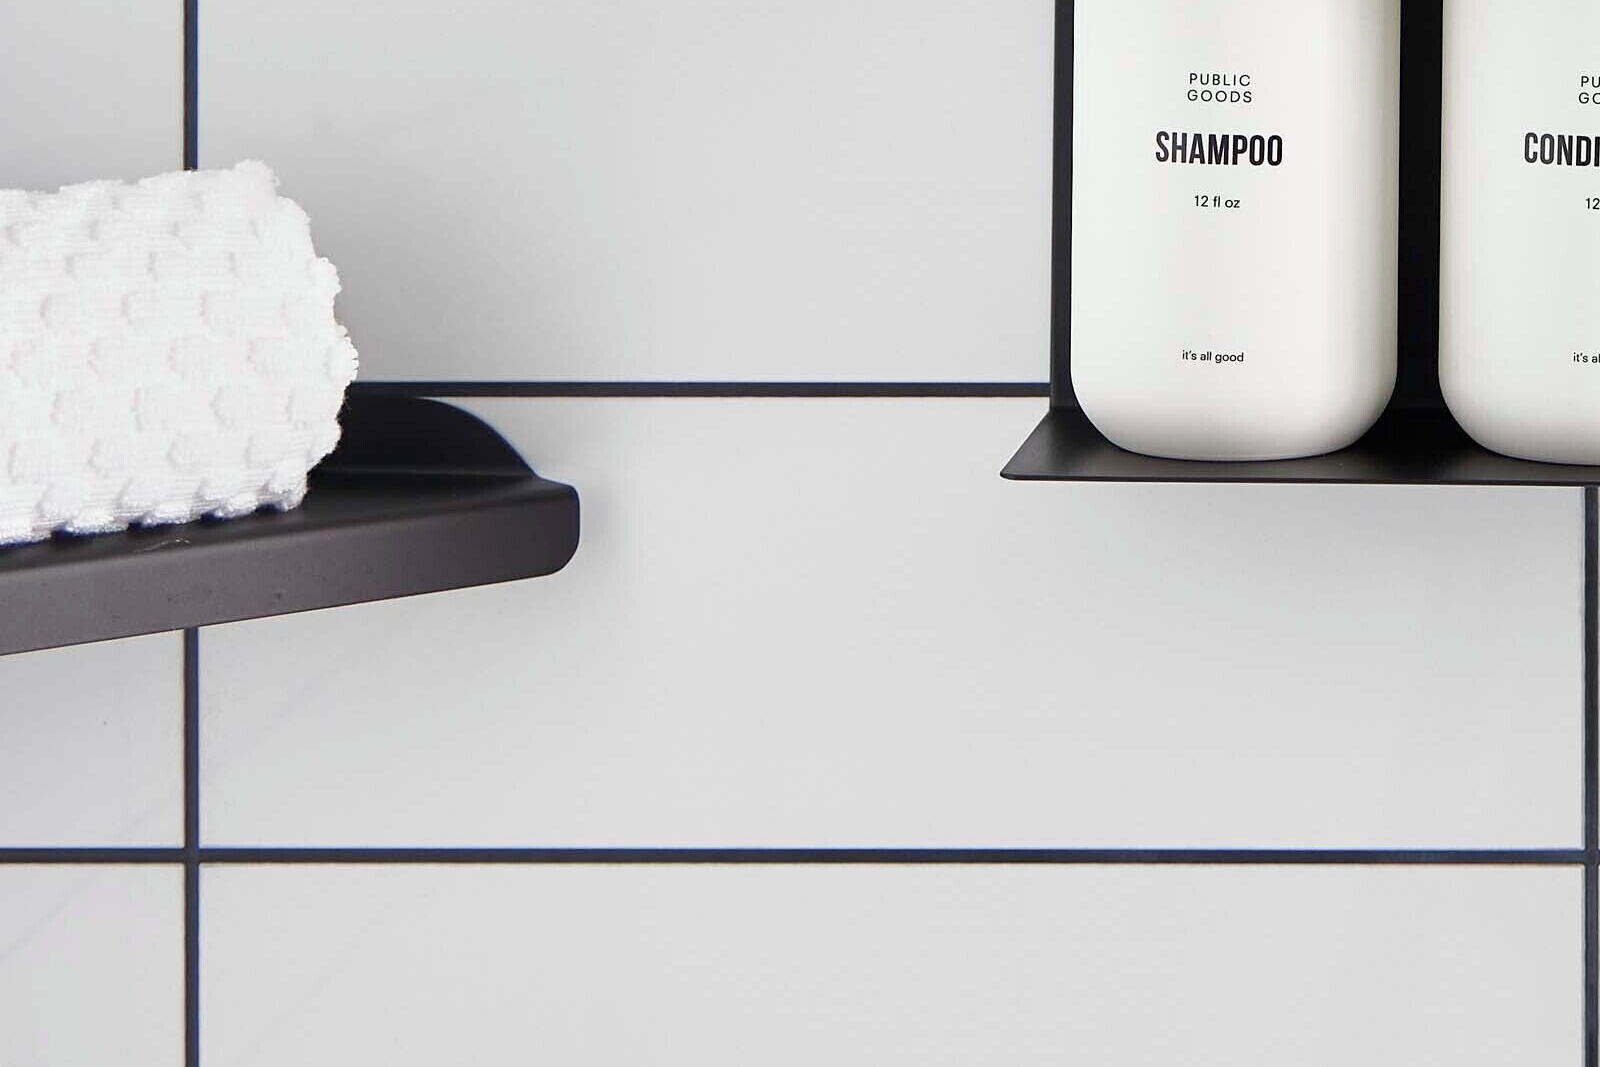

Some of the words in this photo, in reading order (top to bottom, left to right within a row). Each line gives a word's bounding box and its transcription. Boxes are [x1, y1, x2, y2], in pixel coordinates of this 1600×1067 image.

[1189, 72, 1251, 87] PUBLIC
[1187, 89, 1252, 104] GOODS
[1155, 130, 1283, 167] SHAMPOO
[1194, 195, 1209, 208] 12
[1213, 195, 1221, 208] fl
[1224, 199, 1241, 209] oz
[1585, 197, 1600, 211] 12
[1182, 349, 1197, 361] it's
[1200, 350, 1212, 362] all
[1215, 351, 1244, 364] good
[1573, 351, 1589, 363] it's
